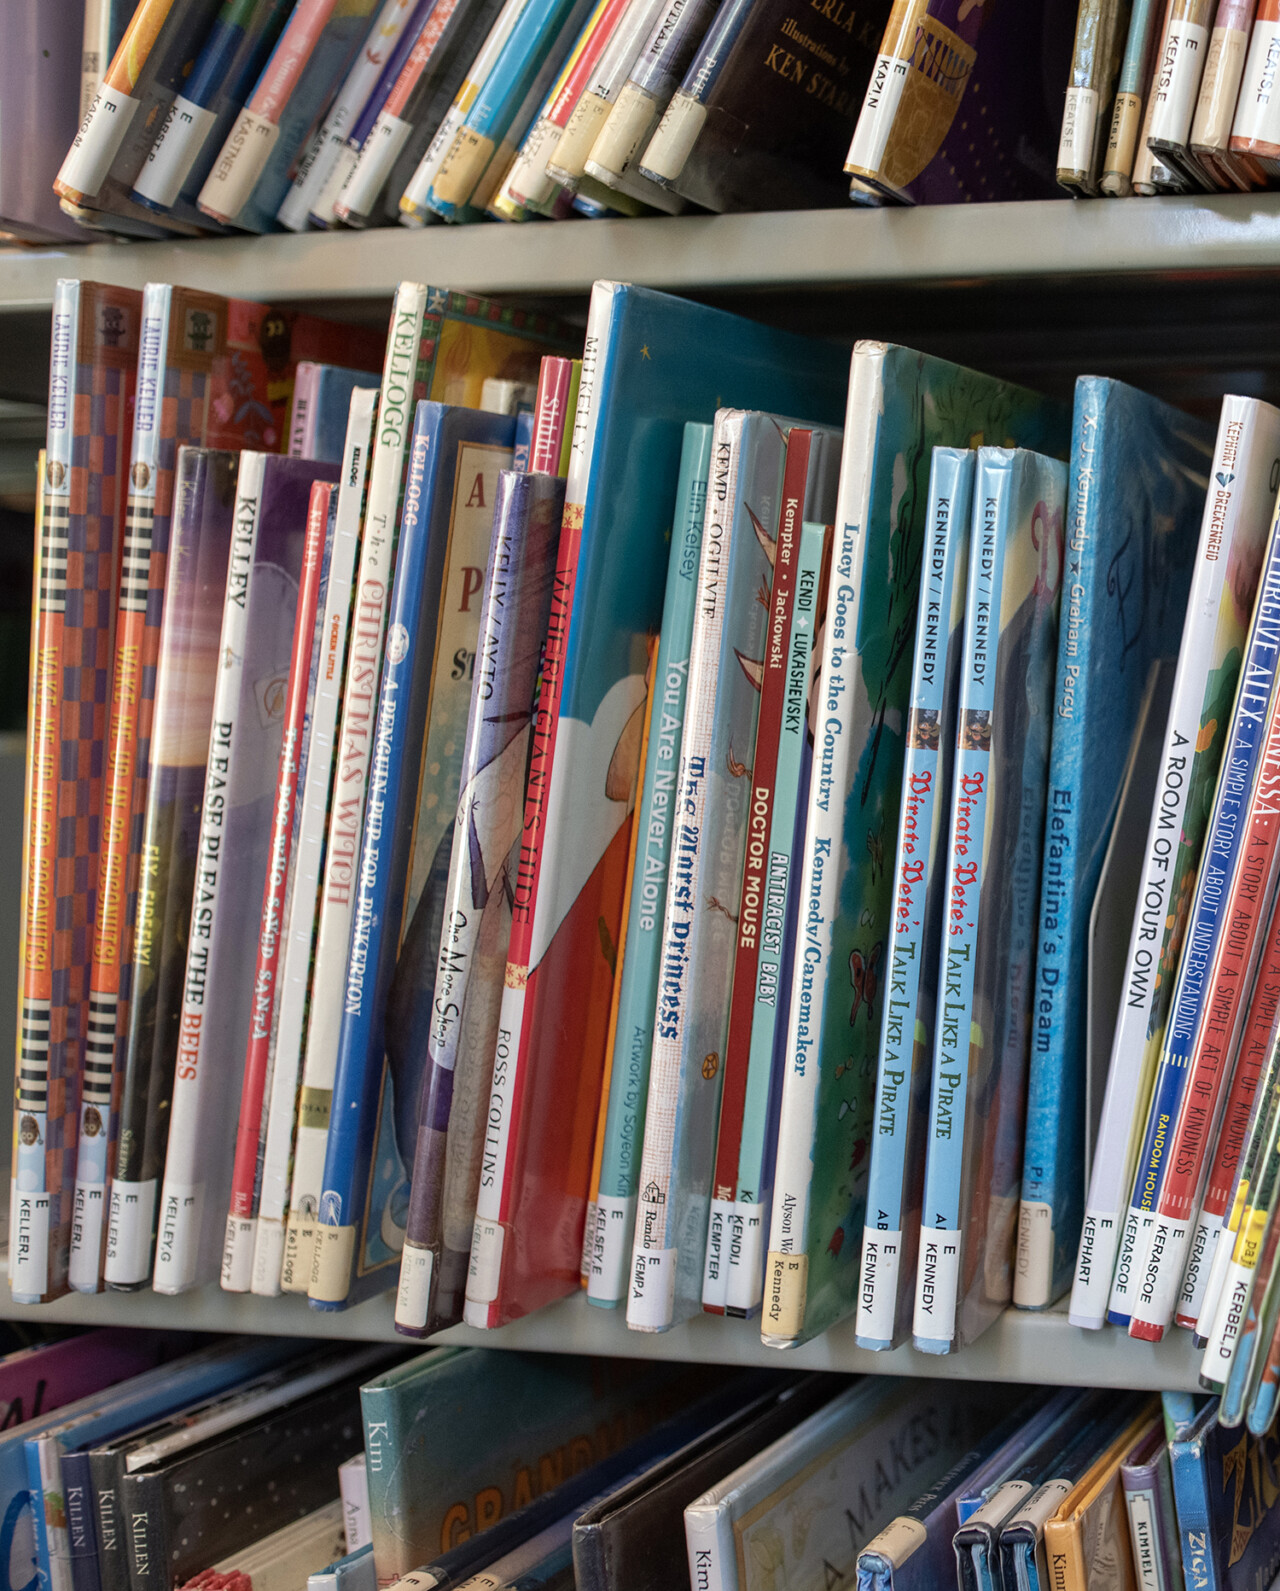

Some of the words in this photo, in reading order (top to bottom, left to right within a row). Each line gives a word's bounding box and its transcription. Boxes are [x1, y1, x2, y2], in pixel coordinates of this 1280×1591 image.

[1156, 35, 1181, 102] KEATS,E
[215, 117, 254, 182] KASTNER
[1063, 94, 1078, 148] KEATS,E
[52, 313, 70, 368] LAURIE
[140, 317, 162, 370] LAURIE
[49, 372, 69, 430] KELLER
[135, 375, 157, 432] KELLER
[380, 311, 419, 449] KELLOGG
[348, 446, 362, 488] KELLOGG
[717, 442, 732, 502] KEMP
[1223, 421, 1245, 470] KEPHART
[403, 434, 430, 527] KELLOGG
[227, 496, 257, 610] KELLEY
[302, 508, 324, 572] KELLEY
[777, 497, 799, 566] Kempter
[835, 522, 861, 578] Lucy
[1203, 490, 1228, 563] BRECKENREID
[701, 522, 725, 620] OGILVIE
[796, 570, 816, 612] KENDI
[541, 568, 571, 700] WHERE
[769, 588, 790, 669] Jackowski
[831, 587, 856, 641] Goes
[341, 579, 385, 785] CHRISTMAS
[664, 659, 689, 705] You
[784, 632, 808, 735] LUKASHEVSKY
[824, 671, 846, 711] the
[829, 648, 846, 668] to
[1232, 659, 1276, 731] ALEX:
[523, 709, 554, 832] GIANTS
[657, 713, 682, 762] Are
[815, 716, 847, 813] Country
[1173, 729, 1190, 748] A
[1236, 737, 1253, 751] A
[204, 721, 232, 822] PLEASE
[1153, 756, 1186, 834] ROOM
[1223, 757, 1249, 808] SIMPLE
[647, 770, 677, 848] Never
[752, 786, 770, 871] DOCTOR
[1211, 811, 1238, 859] STORY
[193, 834, 220, 941] PLEASE
[328, 806, 362, 908] WITCH
[512, 846, 539, 925] HIDE
[1050, 790, 1071, 959] Elefantina's
[1150, 837, 1172, 873] OF
[640, 858, 665, 932] Alone
[741, 875, 761, 949] MOUSE
[762, 852, 790, 955] ANTIRACIST
[1139, 879, 1170, 943] YOUR
[1201, 865, 1226, 914] ABOUT
[187, 949, 211, 1006] THE
[757, 959, 776, 1007] BABY
[794, 836, 832, 1078] Kennedy/Canemaker
[1126, 950, 1156, 1009] OWN
[1173, 920, 1215, 1041] UNDERSTANDING
[1035, 967, 1060, 1055] Dream
[177, 1012, 203, 1082] BEES
[493, 1028, 511, 1087] ROSS
[480, 1091, 505, 1189] COLLINS
[1144, 1113, 1170, 1168] RANDOM
[70, 1187, 86, 1253] KELLER,L
[1139, 1170, 1161, 1213] HOUSE
[17, 1197, 33, 1265] KELLER,L
[106, 1192, 122, 1259] KELLER,S
[158, 1195, 179, 1262] KELLEY,G
[283, 1228, 298, 1284] Kellogg
[708, 1211, 723, 1280] KEMPTER
[1079, 1215, 1097, 1285] KEPHART
[1115, 1213, 1140, 1294] KERASCOE
[769, 1260, 785, 1322] Kennedy
[860, 1241, 877, 1314] KENNEDY
[922, 1241, 938, 1315] KENNEDY
[1140, 1224, 1166, 1305] KERASCOE
[1217, 1279, 1247, 1360] KERBEL,D
[366, 1418, 389, 1474] Kim
[66, 1485, 86, 1548] KILLEN
[98, 1488, 116, 1552] KILLEN
[131, 1511, 151, 1577] KILLEN
[1136, 1520, 1152, 1571] KIMMEL
